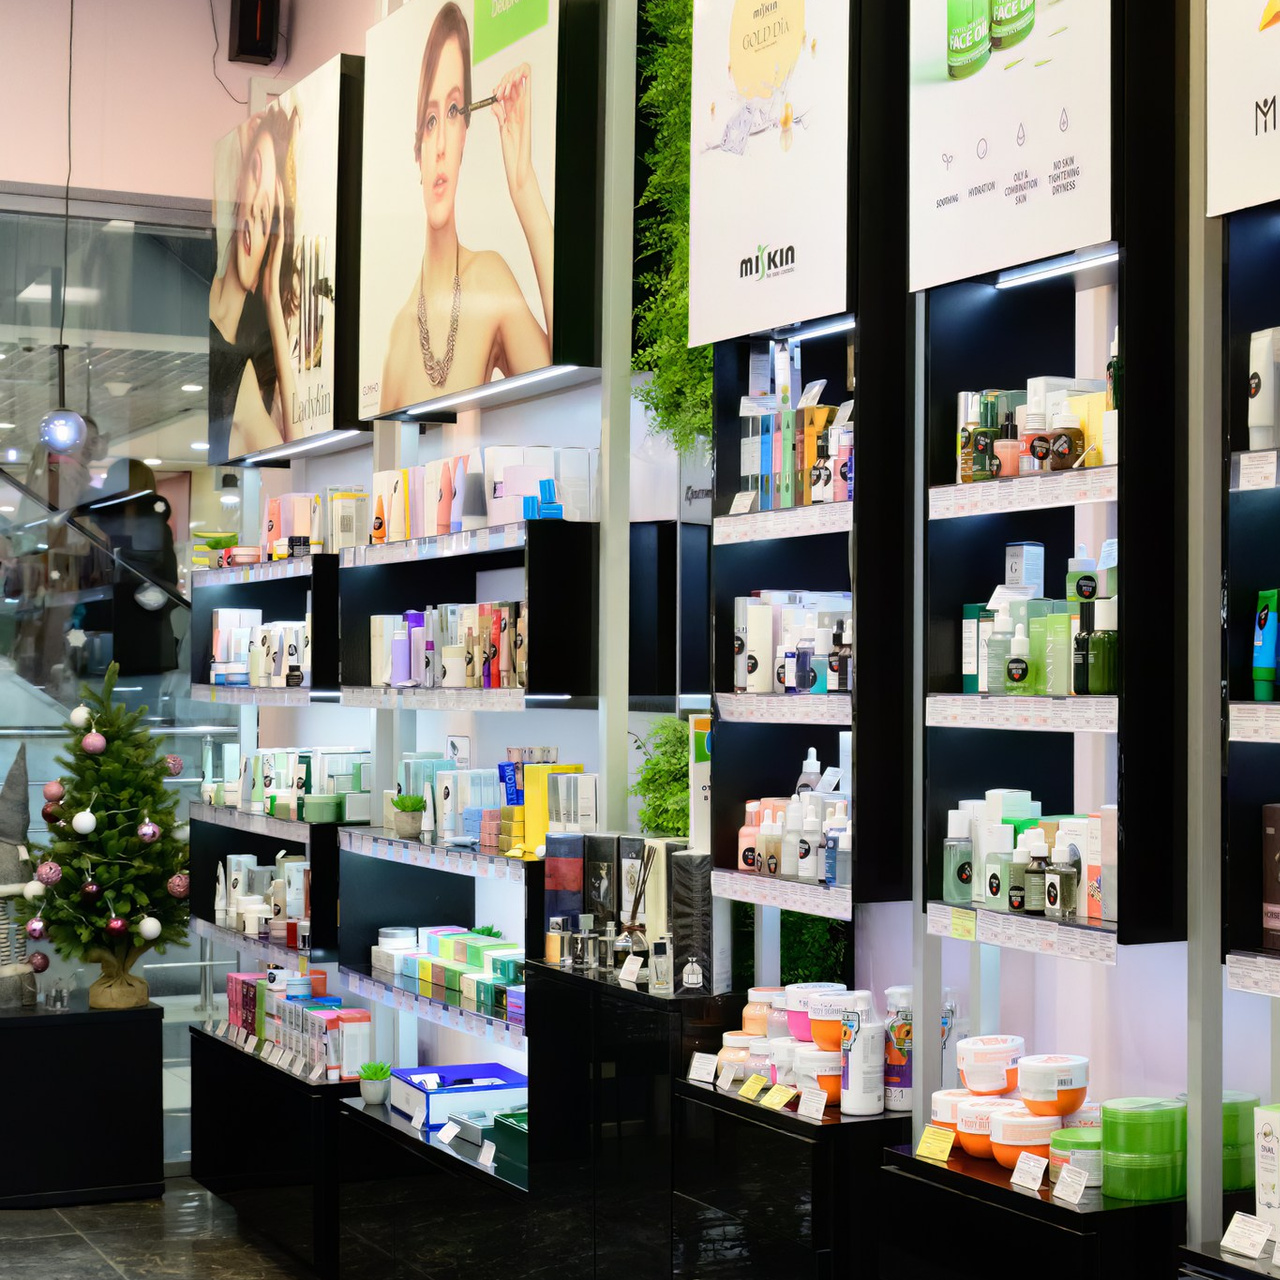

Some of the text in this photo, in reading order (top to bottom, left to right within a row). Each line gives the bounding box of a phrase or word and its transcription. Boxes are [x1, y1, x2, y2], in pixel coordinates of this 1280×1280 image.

[993, 1, 1019, 21] FACE
[742, 25, 771, 50] GOLD
[950, 30, 973, 50] FACE
[974, 20, 989, 41] OIL
[1053, 155, 1075, 171] NO SKIN
[1013, 171, 1024, 183] OILY
[1048, 166, 1080, 185] TIGHTENING
[968, 181, 996, 198] HYDRATION
[1004, 178, 1038, 197] COMBINATION
[1052, 180, 1076, 196] DRYNESS
[936, 193, 959, 208] SOOTHING
[1015, 193, 1027, 205] SKIN
[292, 383, 331, 431] Ladykin
[1261, 1144, 1275, 1155] SNAIL
